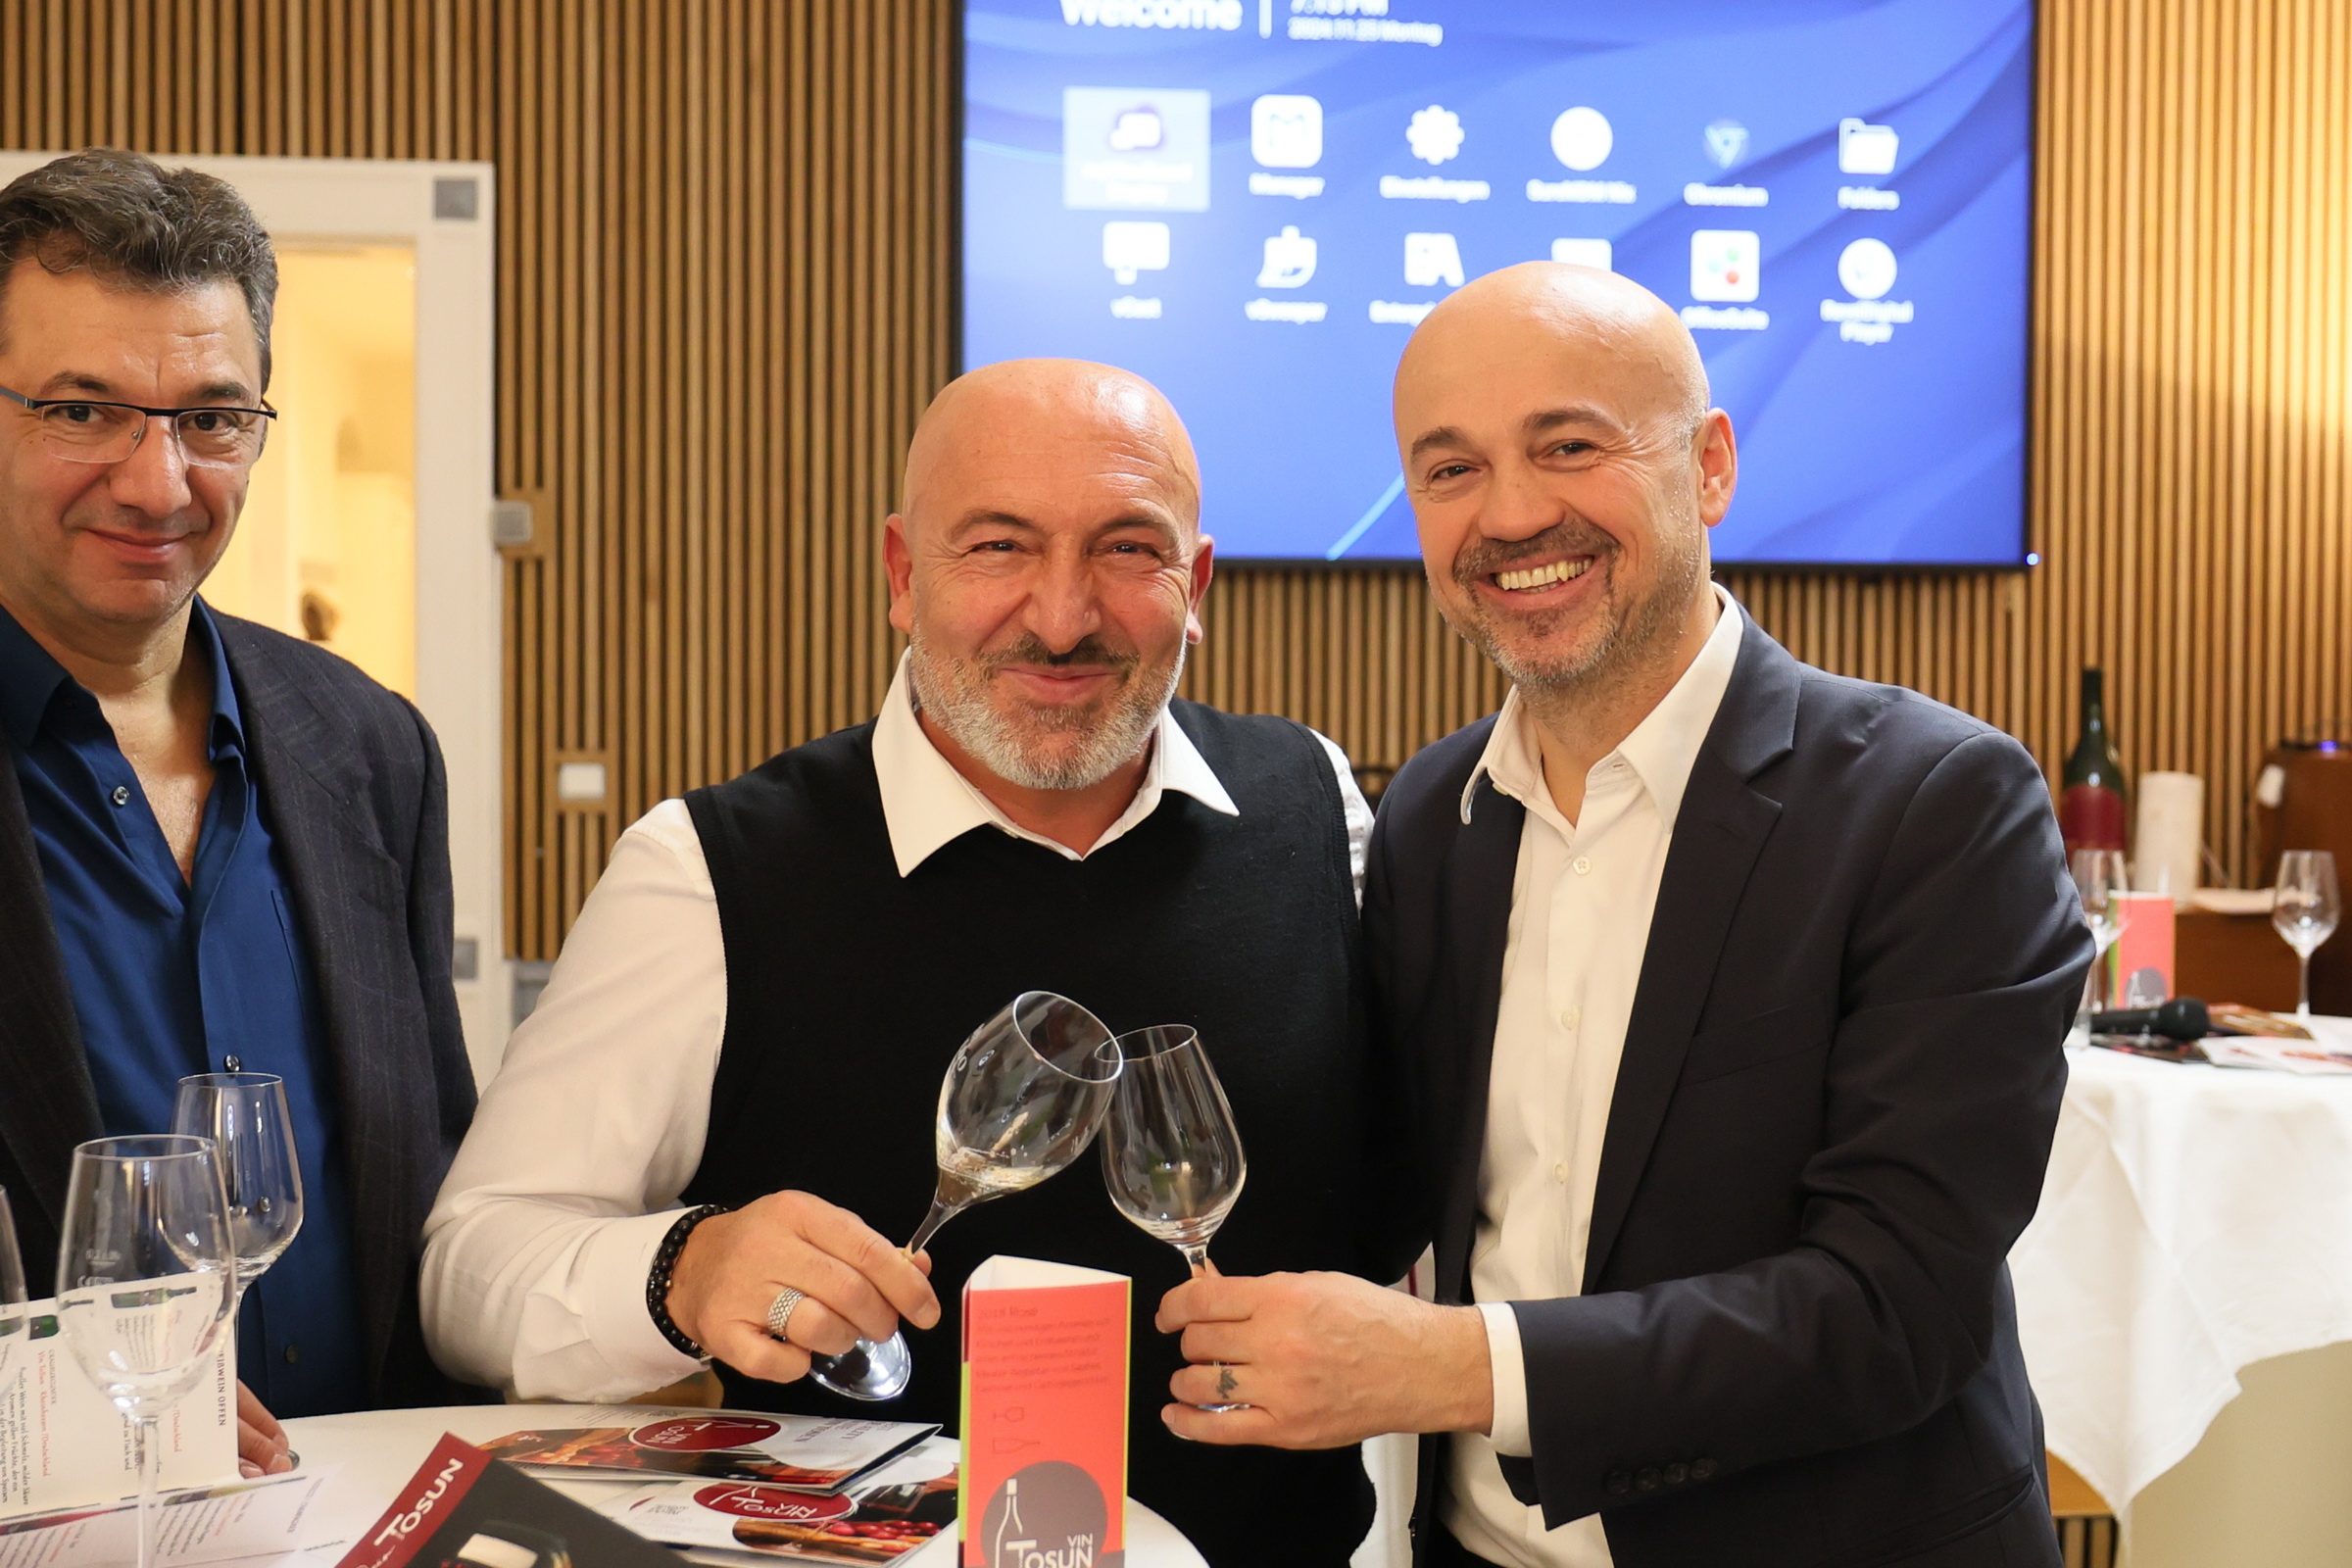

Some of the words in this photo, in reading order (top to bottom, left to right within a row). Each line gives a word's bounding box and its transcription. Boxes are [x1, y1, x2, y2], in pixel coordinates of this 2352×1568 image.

[218, 1396, 226, 1427] OFFEN
[373, 1457, 464, 1546] TOSUN
[1005, 1540, 1094, 1568] TOSUN
[1066, 1533, 1094, 1547] VIN
